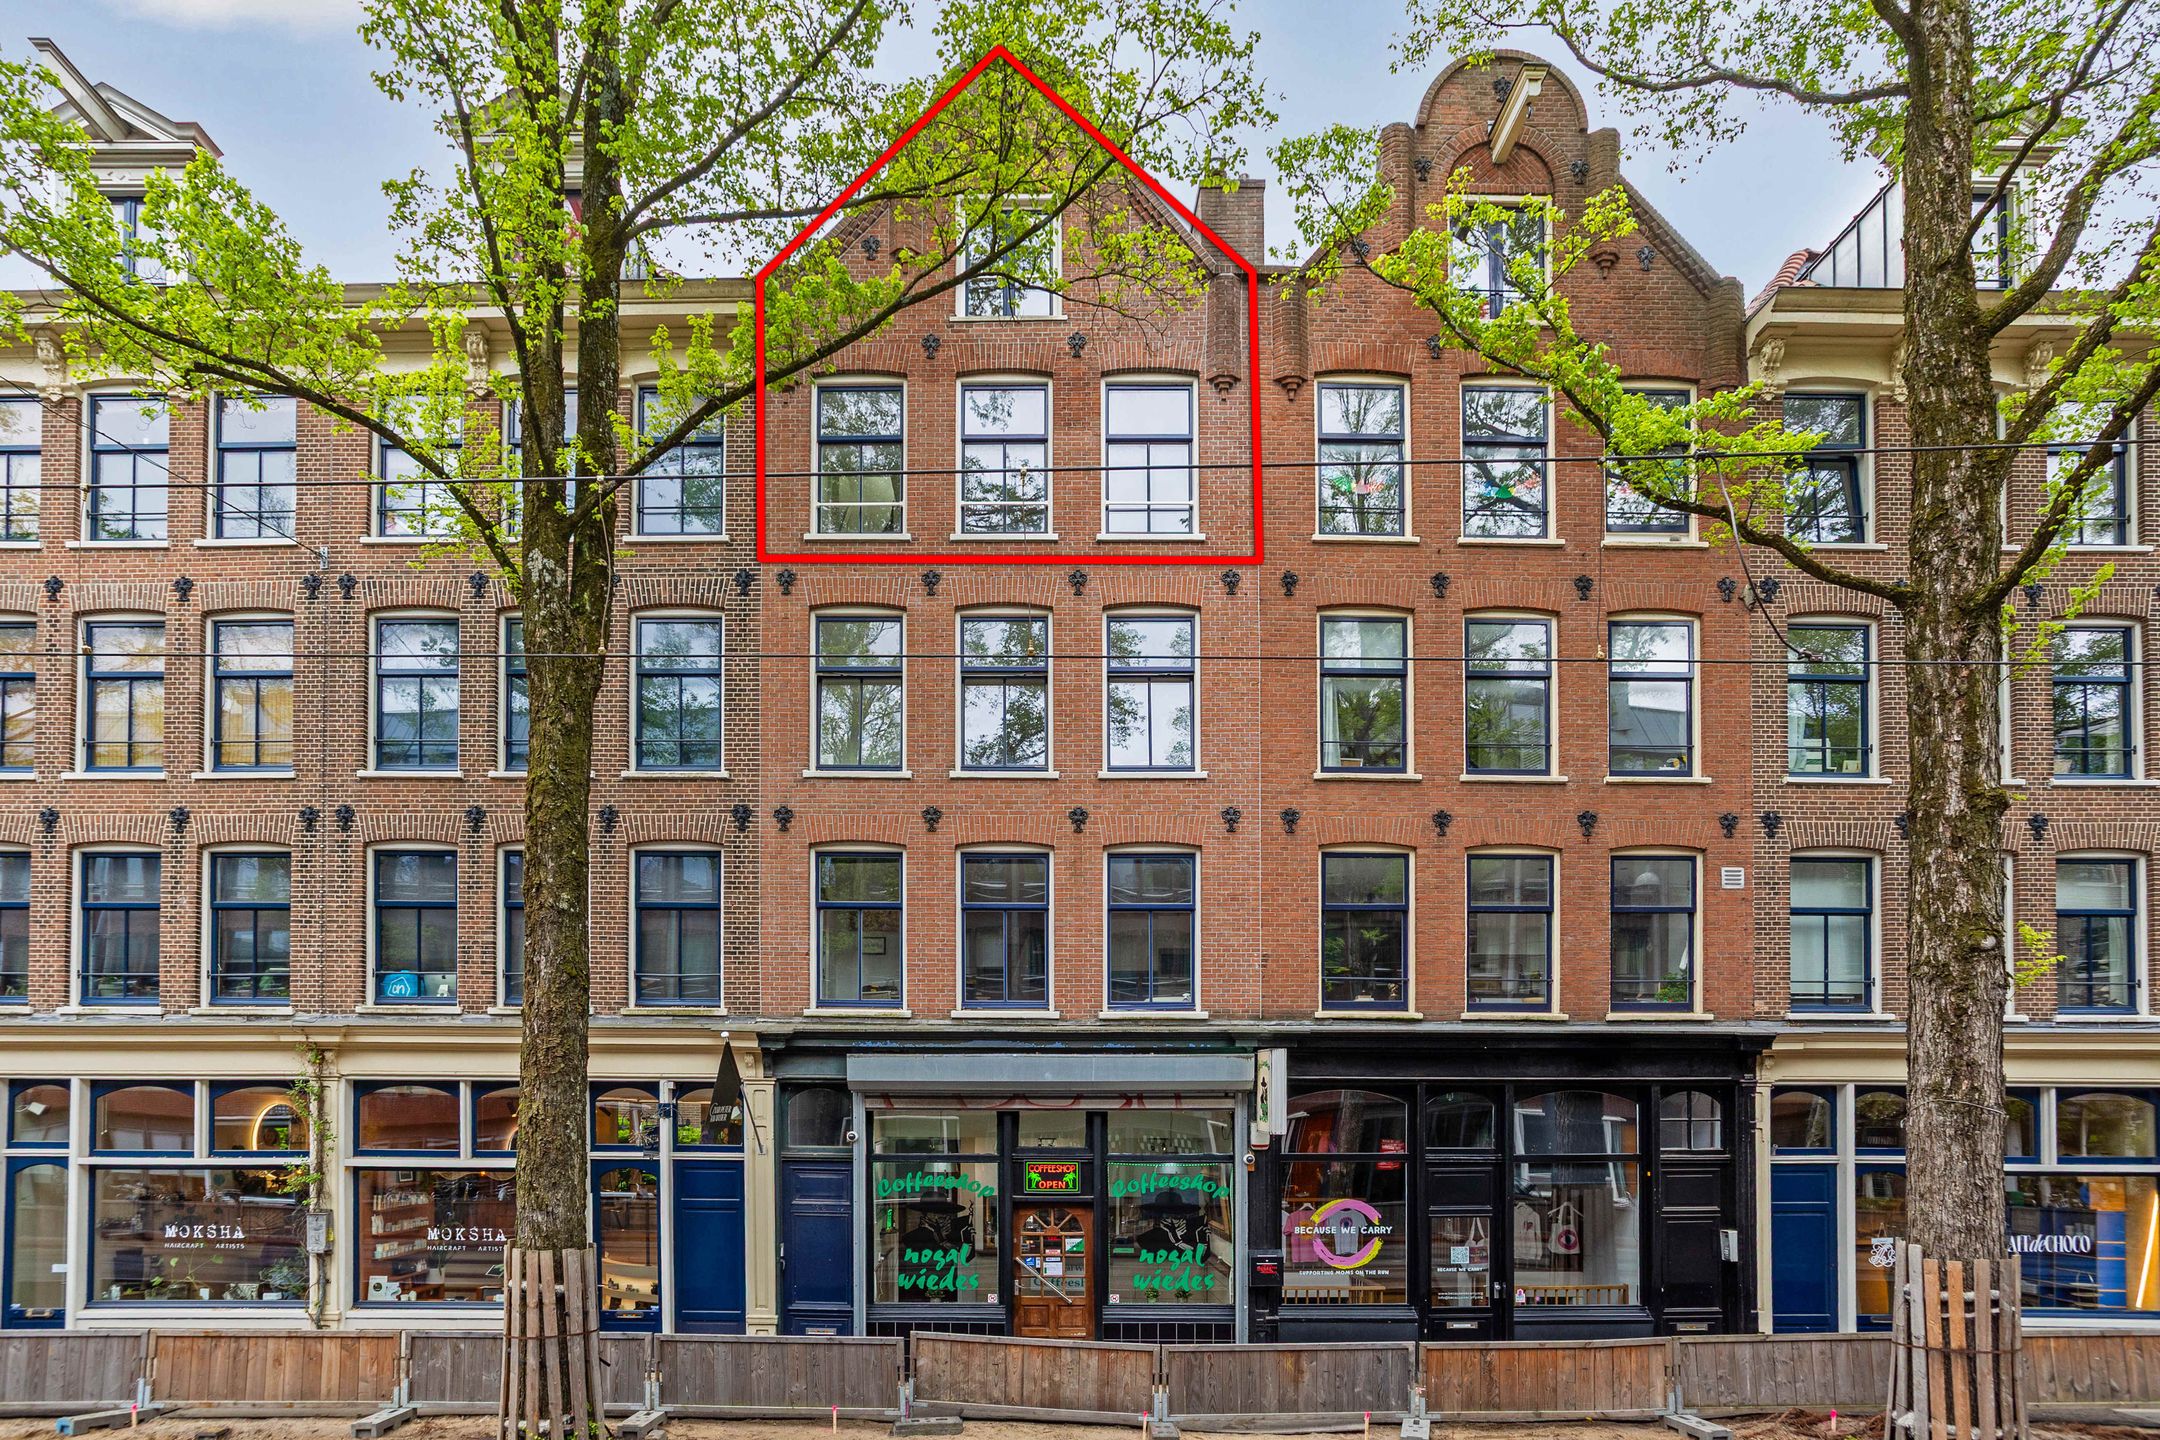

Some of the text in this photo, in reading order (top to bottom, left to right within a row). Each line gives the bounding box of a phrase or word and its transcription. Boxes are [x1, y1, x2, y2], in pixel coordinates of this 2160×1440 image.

[1028, 1164, 1076, 1173] COFFEESHOP
[877, 1171, 995, 1198] Coffeeshop
[1038, 1180, 1066, 1189] OPEN
[1111, 1171, 1230, 1199] Coffeeshop
[164, 1221, 246, 1239] MOKSHA
[427, 1225, 507, 1242] MOKSHA
[1294, 1226, 1393, 1234] BECAUSE WE CARRY
[904, 1243, 971, 1271] nogal
[1138, 1243, 1206, 1271] nogal
[898, 1266, 979, 1292] wiedes
[1132, 1266, 1215, 1292] wiedes
[1355, 1269, 1364, 1277] ON
